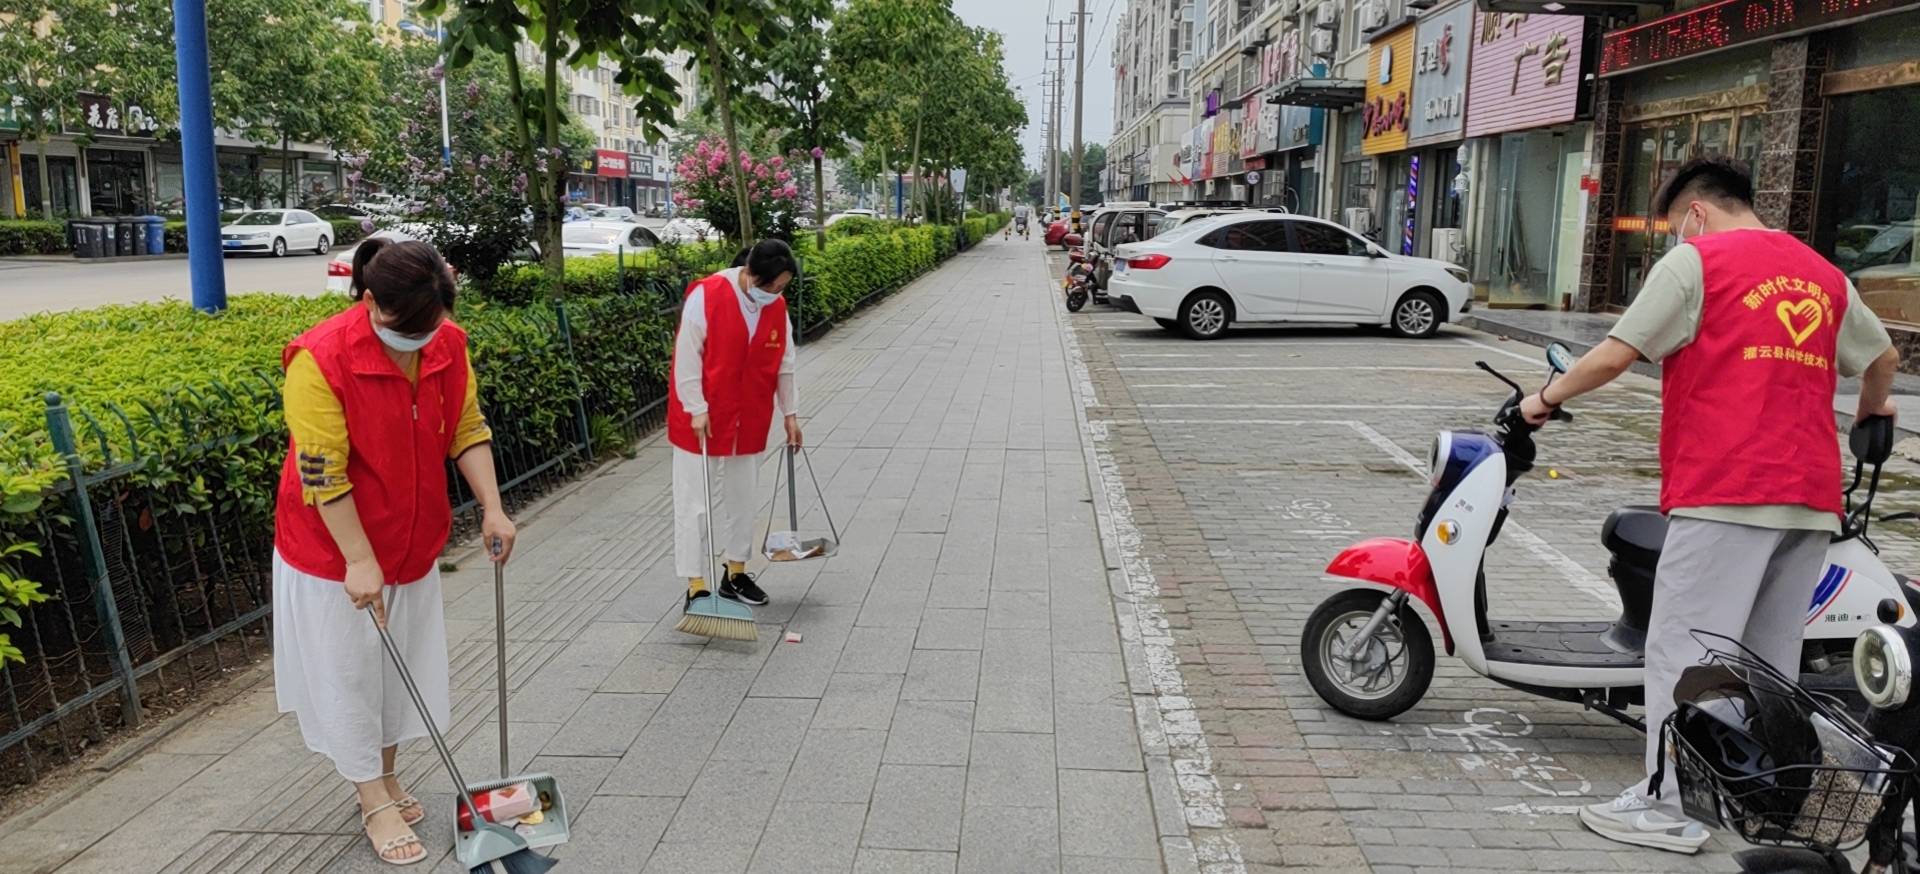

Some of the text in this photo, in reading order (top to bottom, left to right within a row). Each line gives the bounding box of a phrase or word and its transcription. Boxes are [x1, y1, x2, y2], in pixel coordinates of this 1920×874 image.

[1508, 30, 1570, 95] 广告
[1744, 346, 1828, 370] 灌云县科学技术
[1824, 613, 1849, 623] 雅迪
